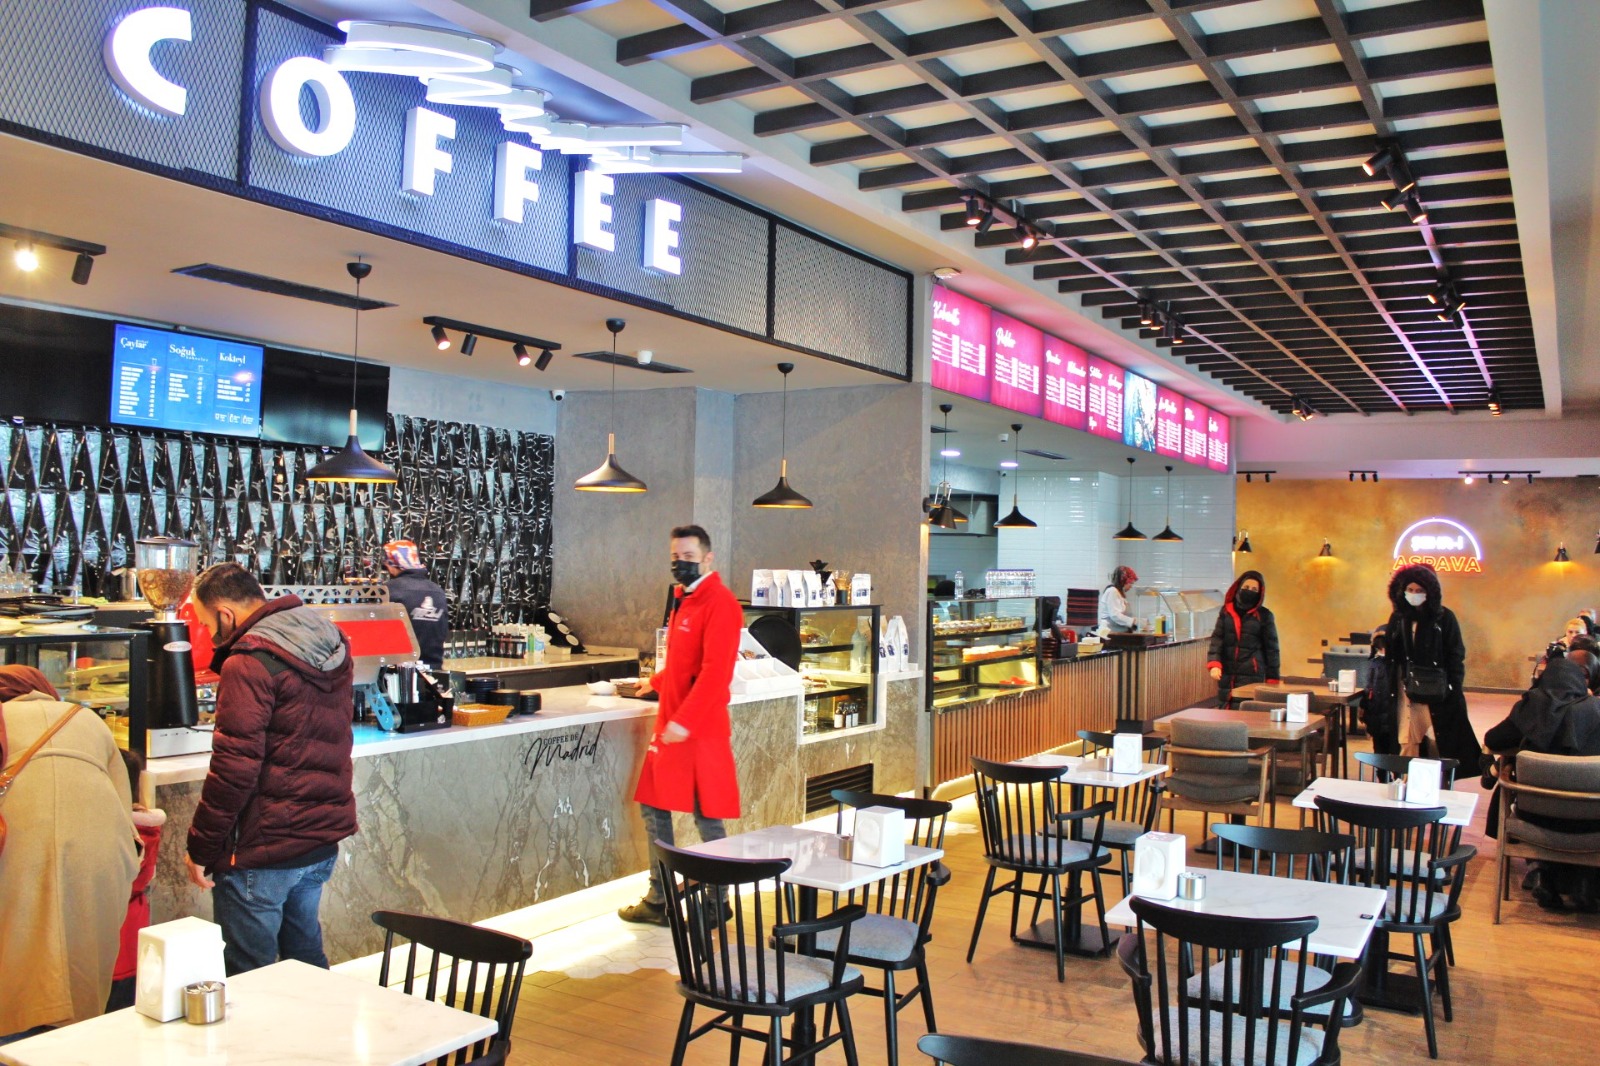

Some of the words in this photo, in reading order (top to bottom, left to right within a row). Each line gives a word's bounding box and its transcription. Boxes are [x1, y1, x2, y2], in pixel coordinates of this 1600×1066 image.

[105, 6, 683, 276] COFFEE
[120, 337, 148, 350] Çaylar
[169, 343, 196, 358] Soğuk
[219, 352, 246, 367] Kokteyl
[1393, 555, 1481, 573] ASPAVA
[543, 734, 569, 746] COFFEE
[524, 721, 605, 780] Madrid
